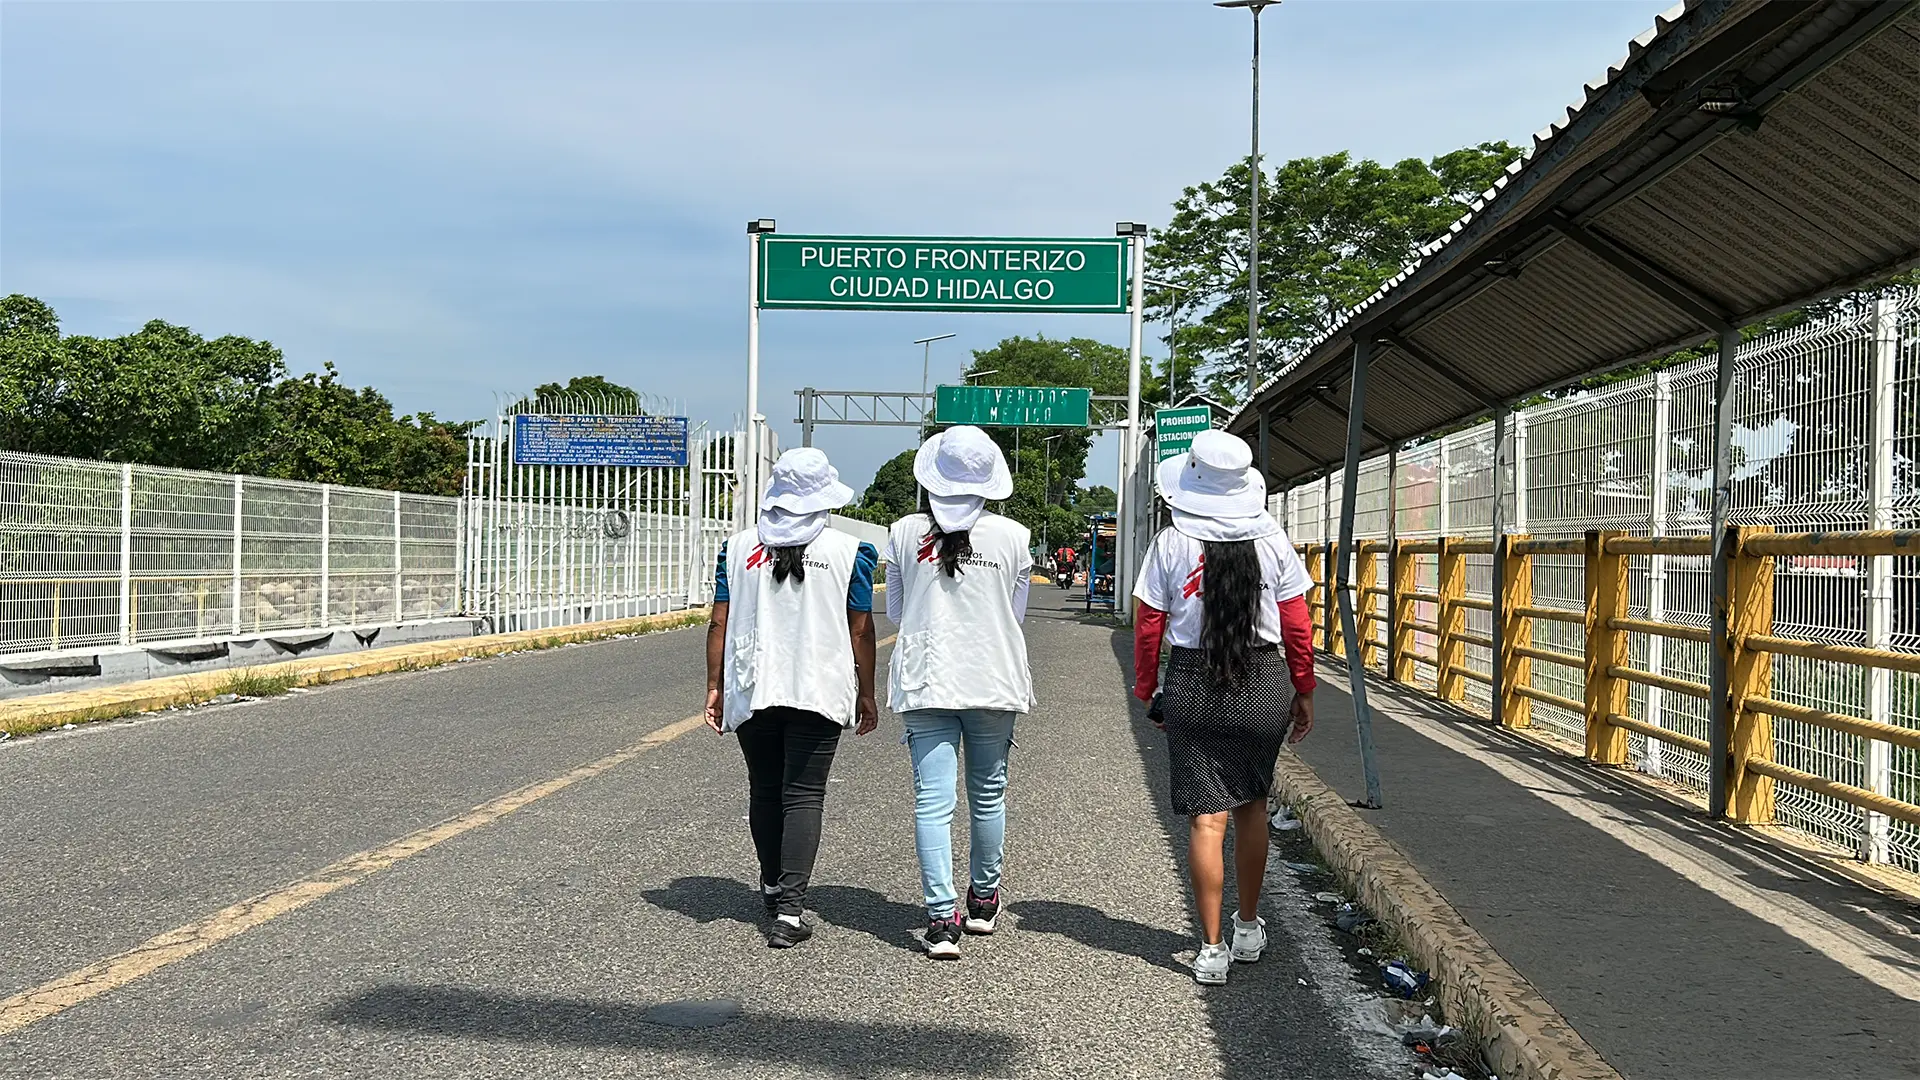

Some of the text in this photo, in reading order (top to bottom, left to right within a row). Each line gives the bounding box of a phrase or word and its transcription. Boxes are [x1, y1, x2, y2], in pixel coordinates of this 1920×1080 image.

[800, 246, 1086, 272] PUERTO FRONTERIZO
[830, 276, 1054, 300] CIUDAD HIDALGO
[1160, 414, 1206, 426] PROHIBIDO
